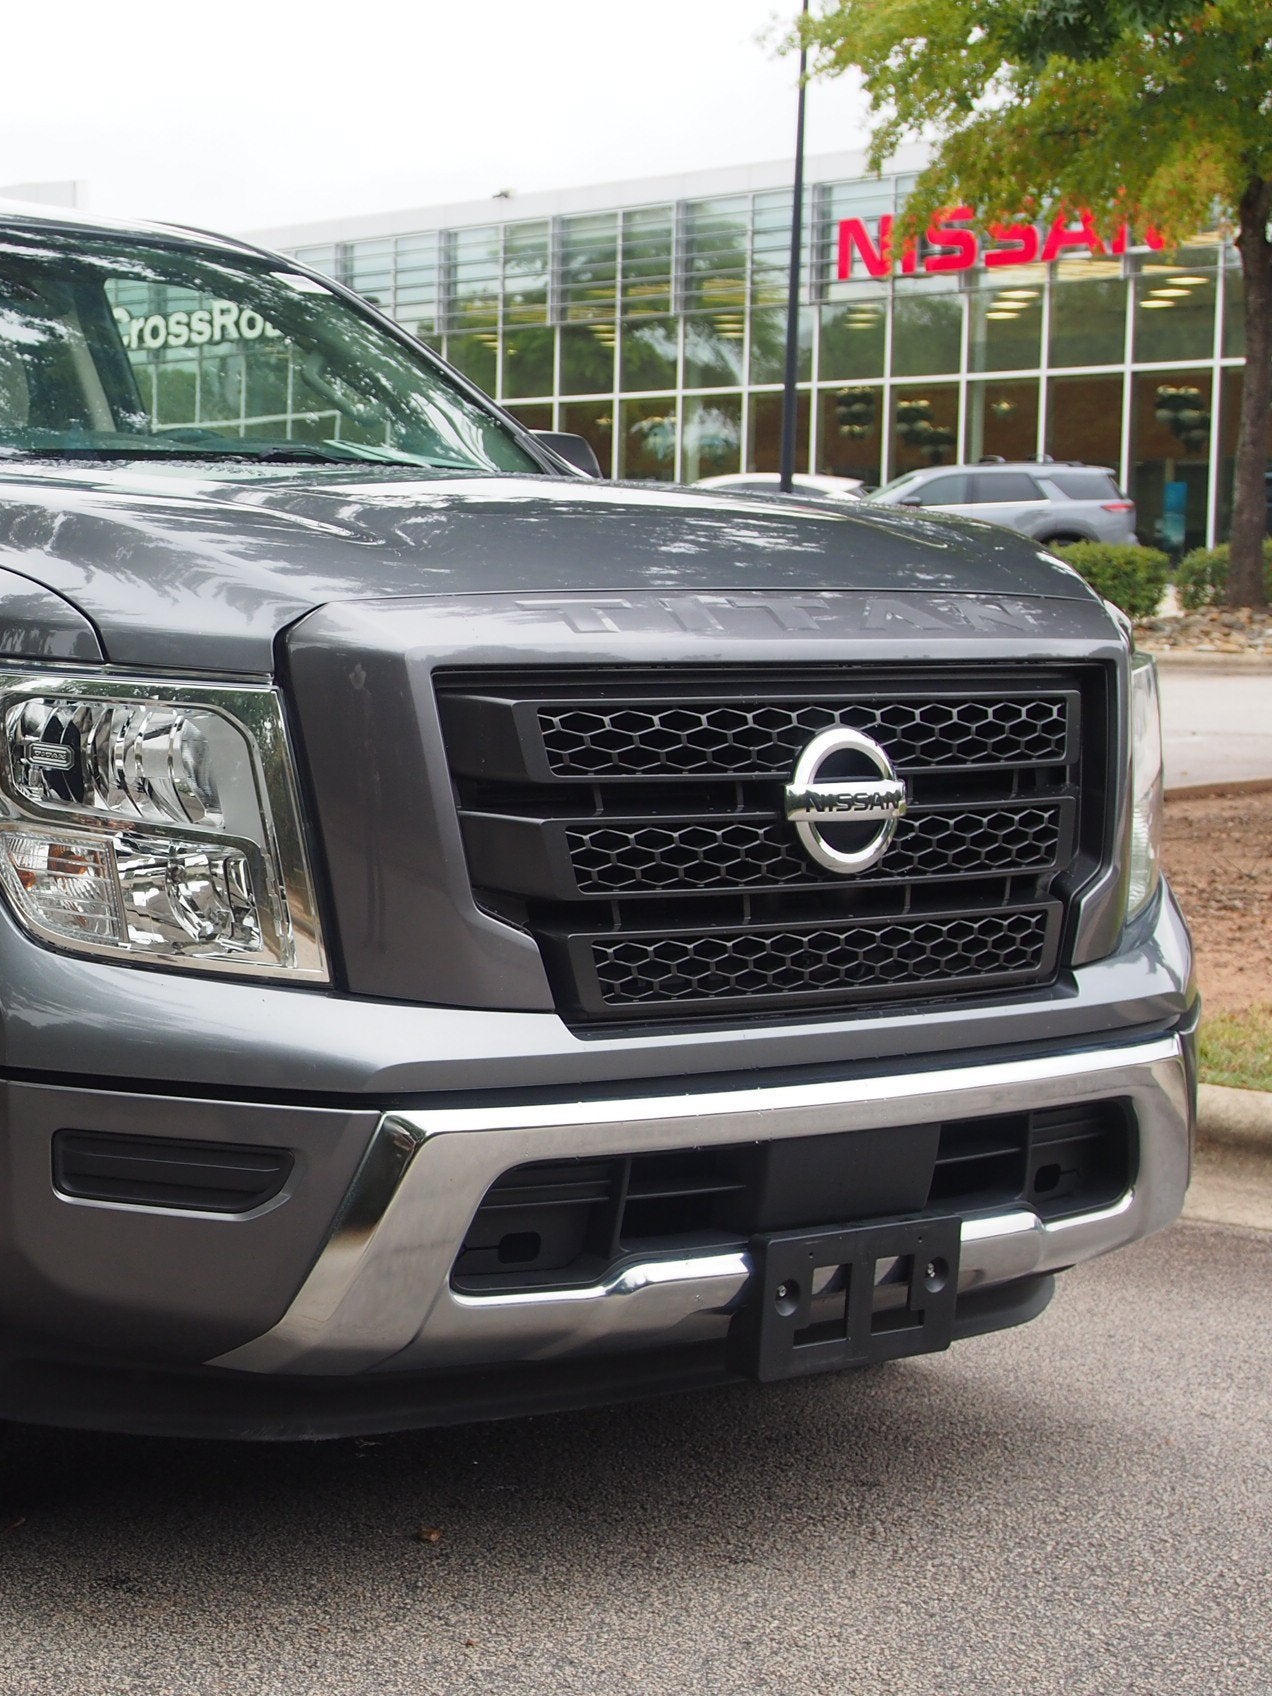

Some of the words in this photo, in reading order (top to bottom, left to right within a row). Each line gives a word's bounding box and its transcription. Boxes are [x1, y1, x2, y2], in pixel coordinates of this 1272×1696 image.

[838, 203, 1166, 280] NISSA
[514, 596, 1039, 634] TITAN
[805, 789, 901, 813] NISSAN
